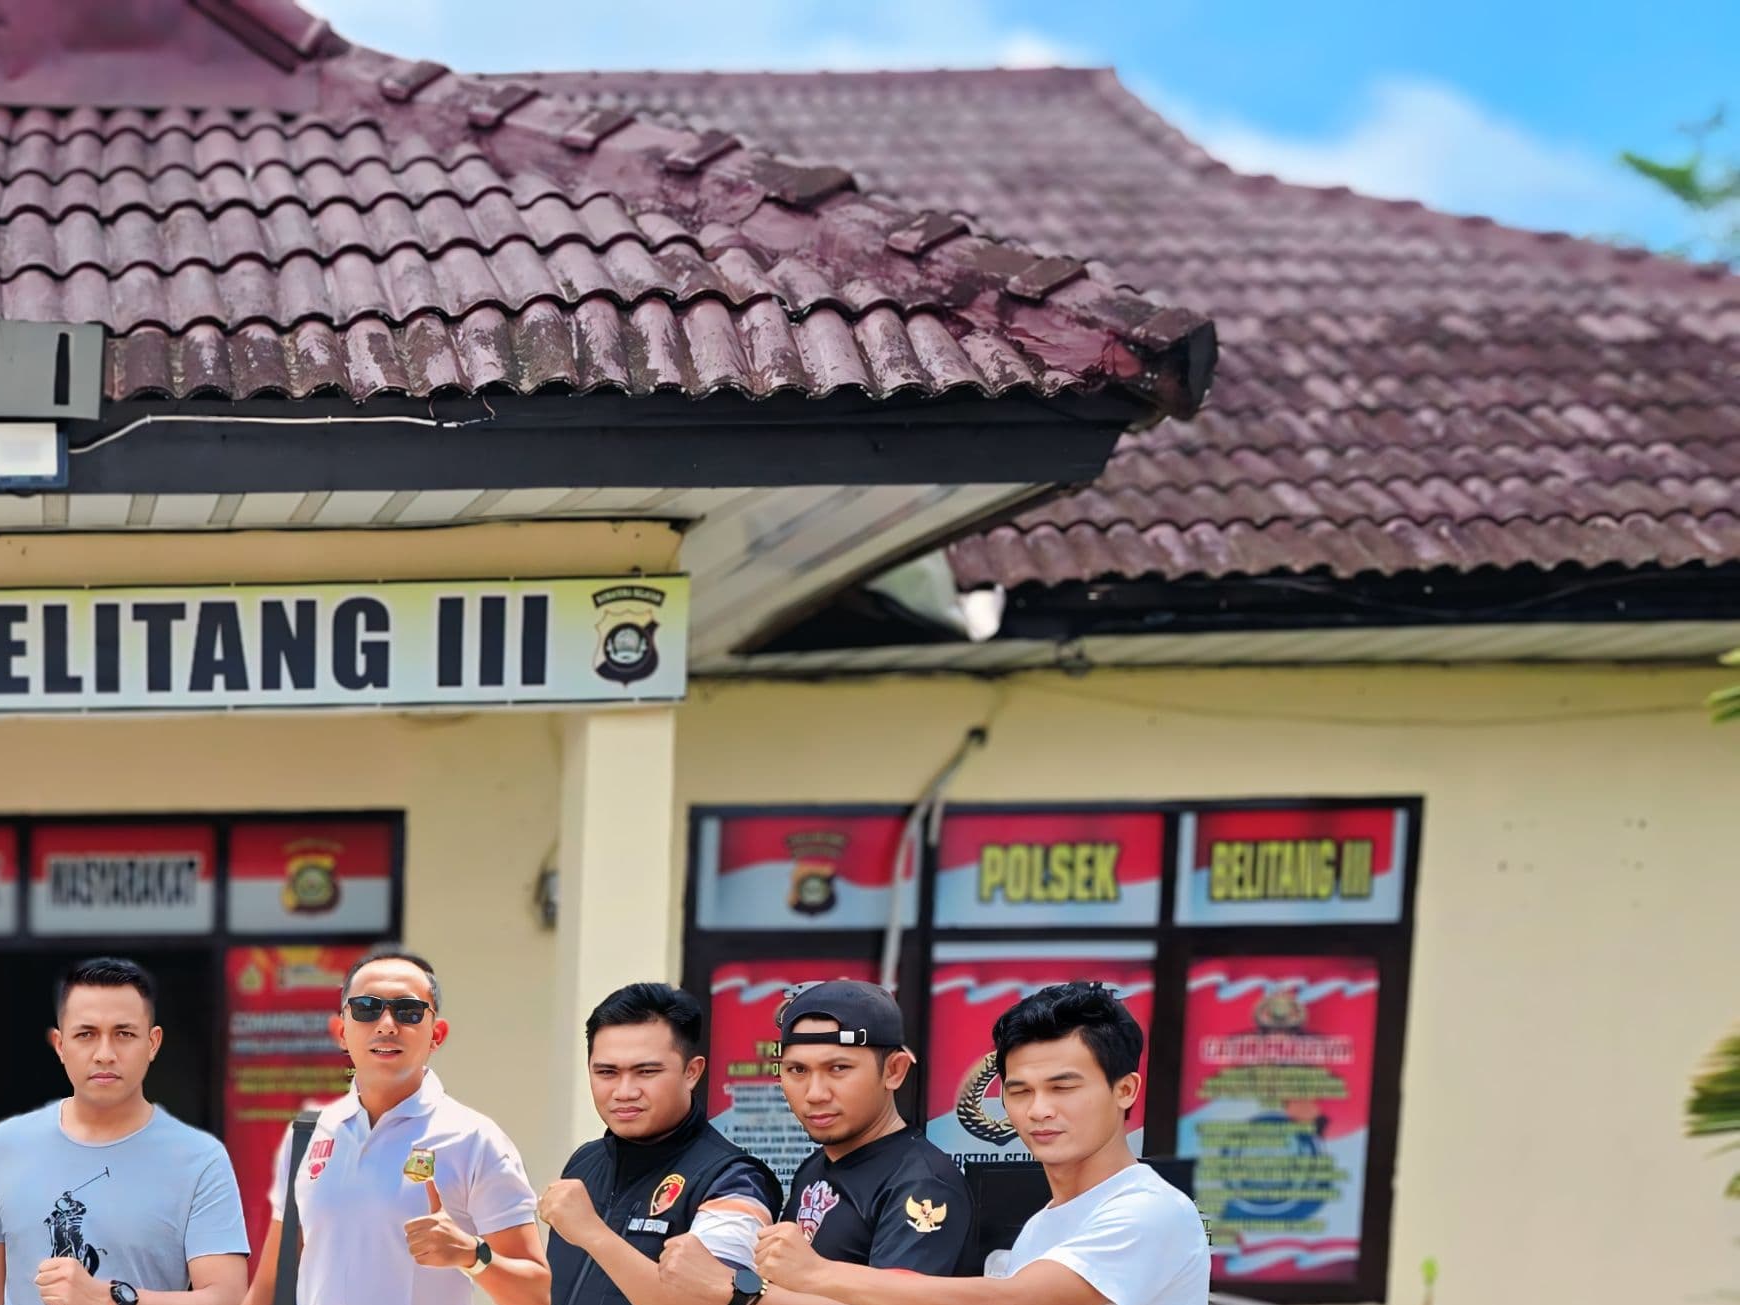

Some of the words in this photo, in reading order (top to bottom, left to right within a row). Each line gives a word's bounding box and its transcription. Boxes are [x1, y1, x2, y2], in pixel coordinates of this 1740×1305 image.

[436, 594, 549, 688] III
[47, 855, 199, 908] MASYARAKAT
[979, 842, 1121, 903] POLSEK
[1210, 840, 1337, 902] BELITANG
[1341, 840, 1374, 900] III
